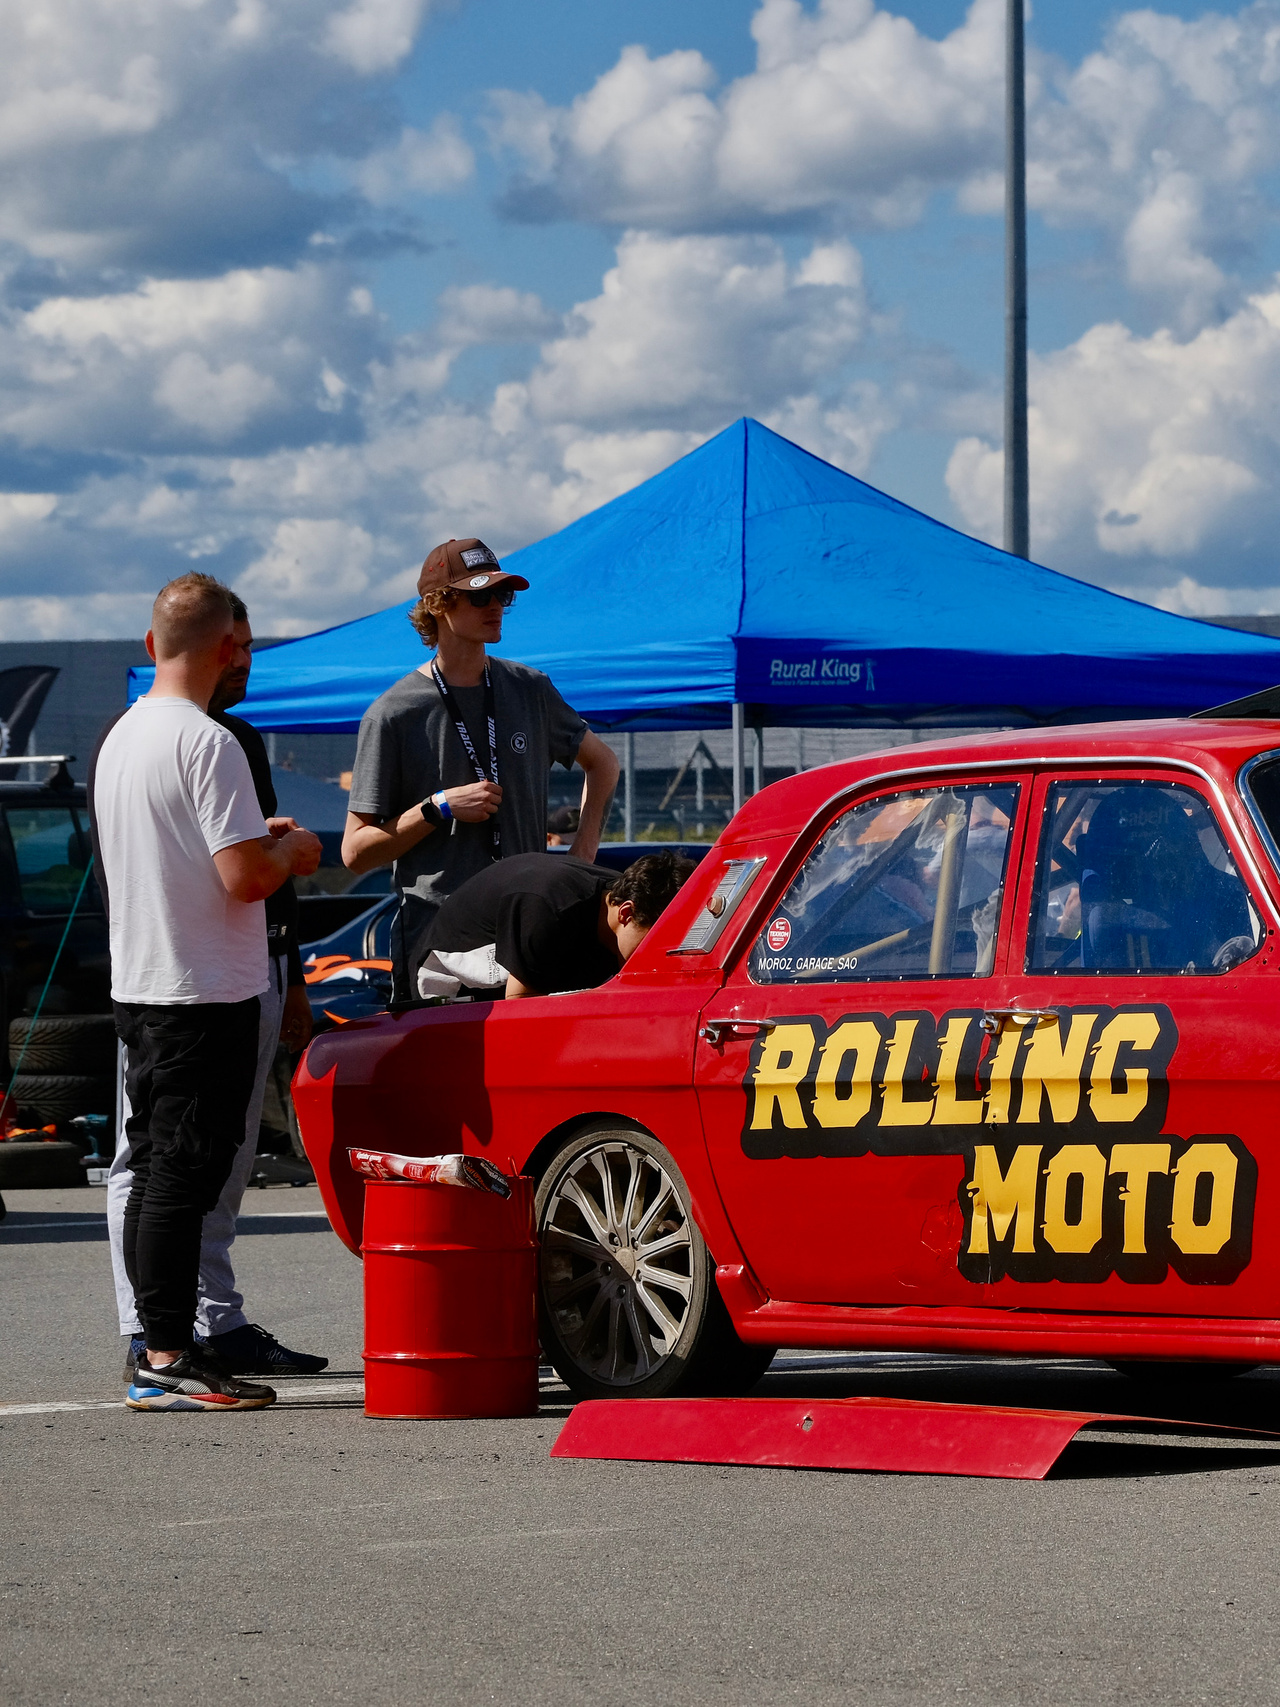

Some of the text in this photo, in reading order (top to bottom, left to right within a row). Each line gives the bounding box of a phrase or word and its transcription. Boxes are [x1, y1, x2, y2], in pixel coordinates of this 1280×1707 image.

[769, 658, 860, 682] Rural King
[455, 721, 475, 754] TRACK
[487, 716, 496, 748] MODE
[758, 957, 858, 972] MOROZ_GARAGE_SAO
[749, 1012, 1162, 1130] ROLLING
[967, 1142, 1239, 1255] MOTO
